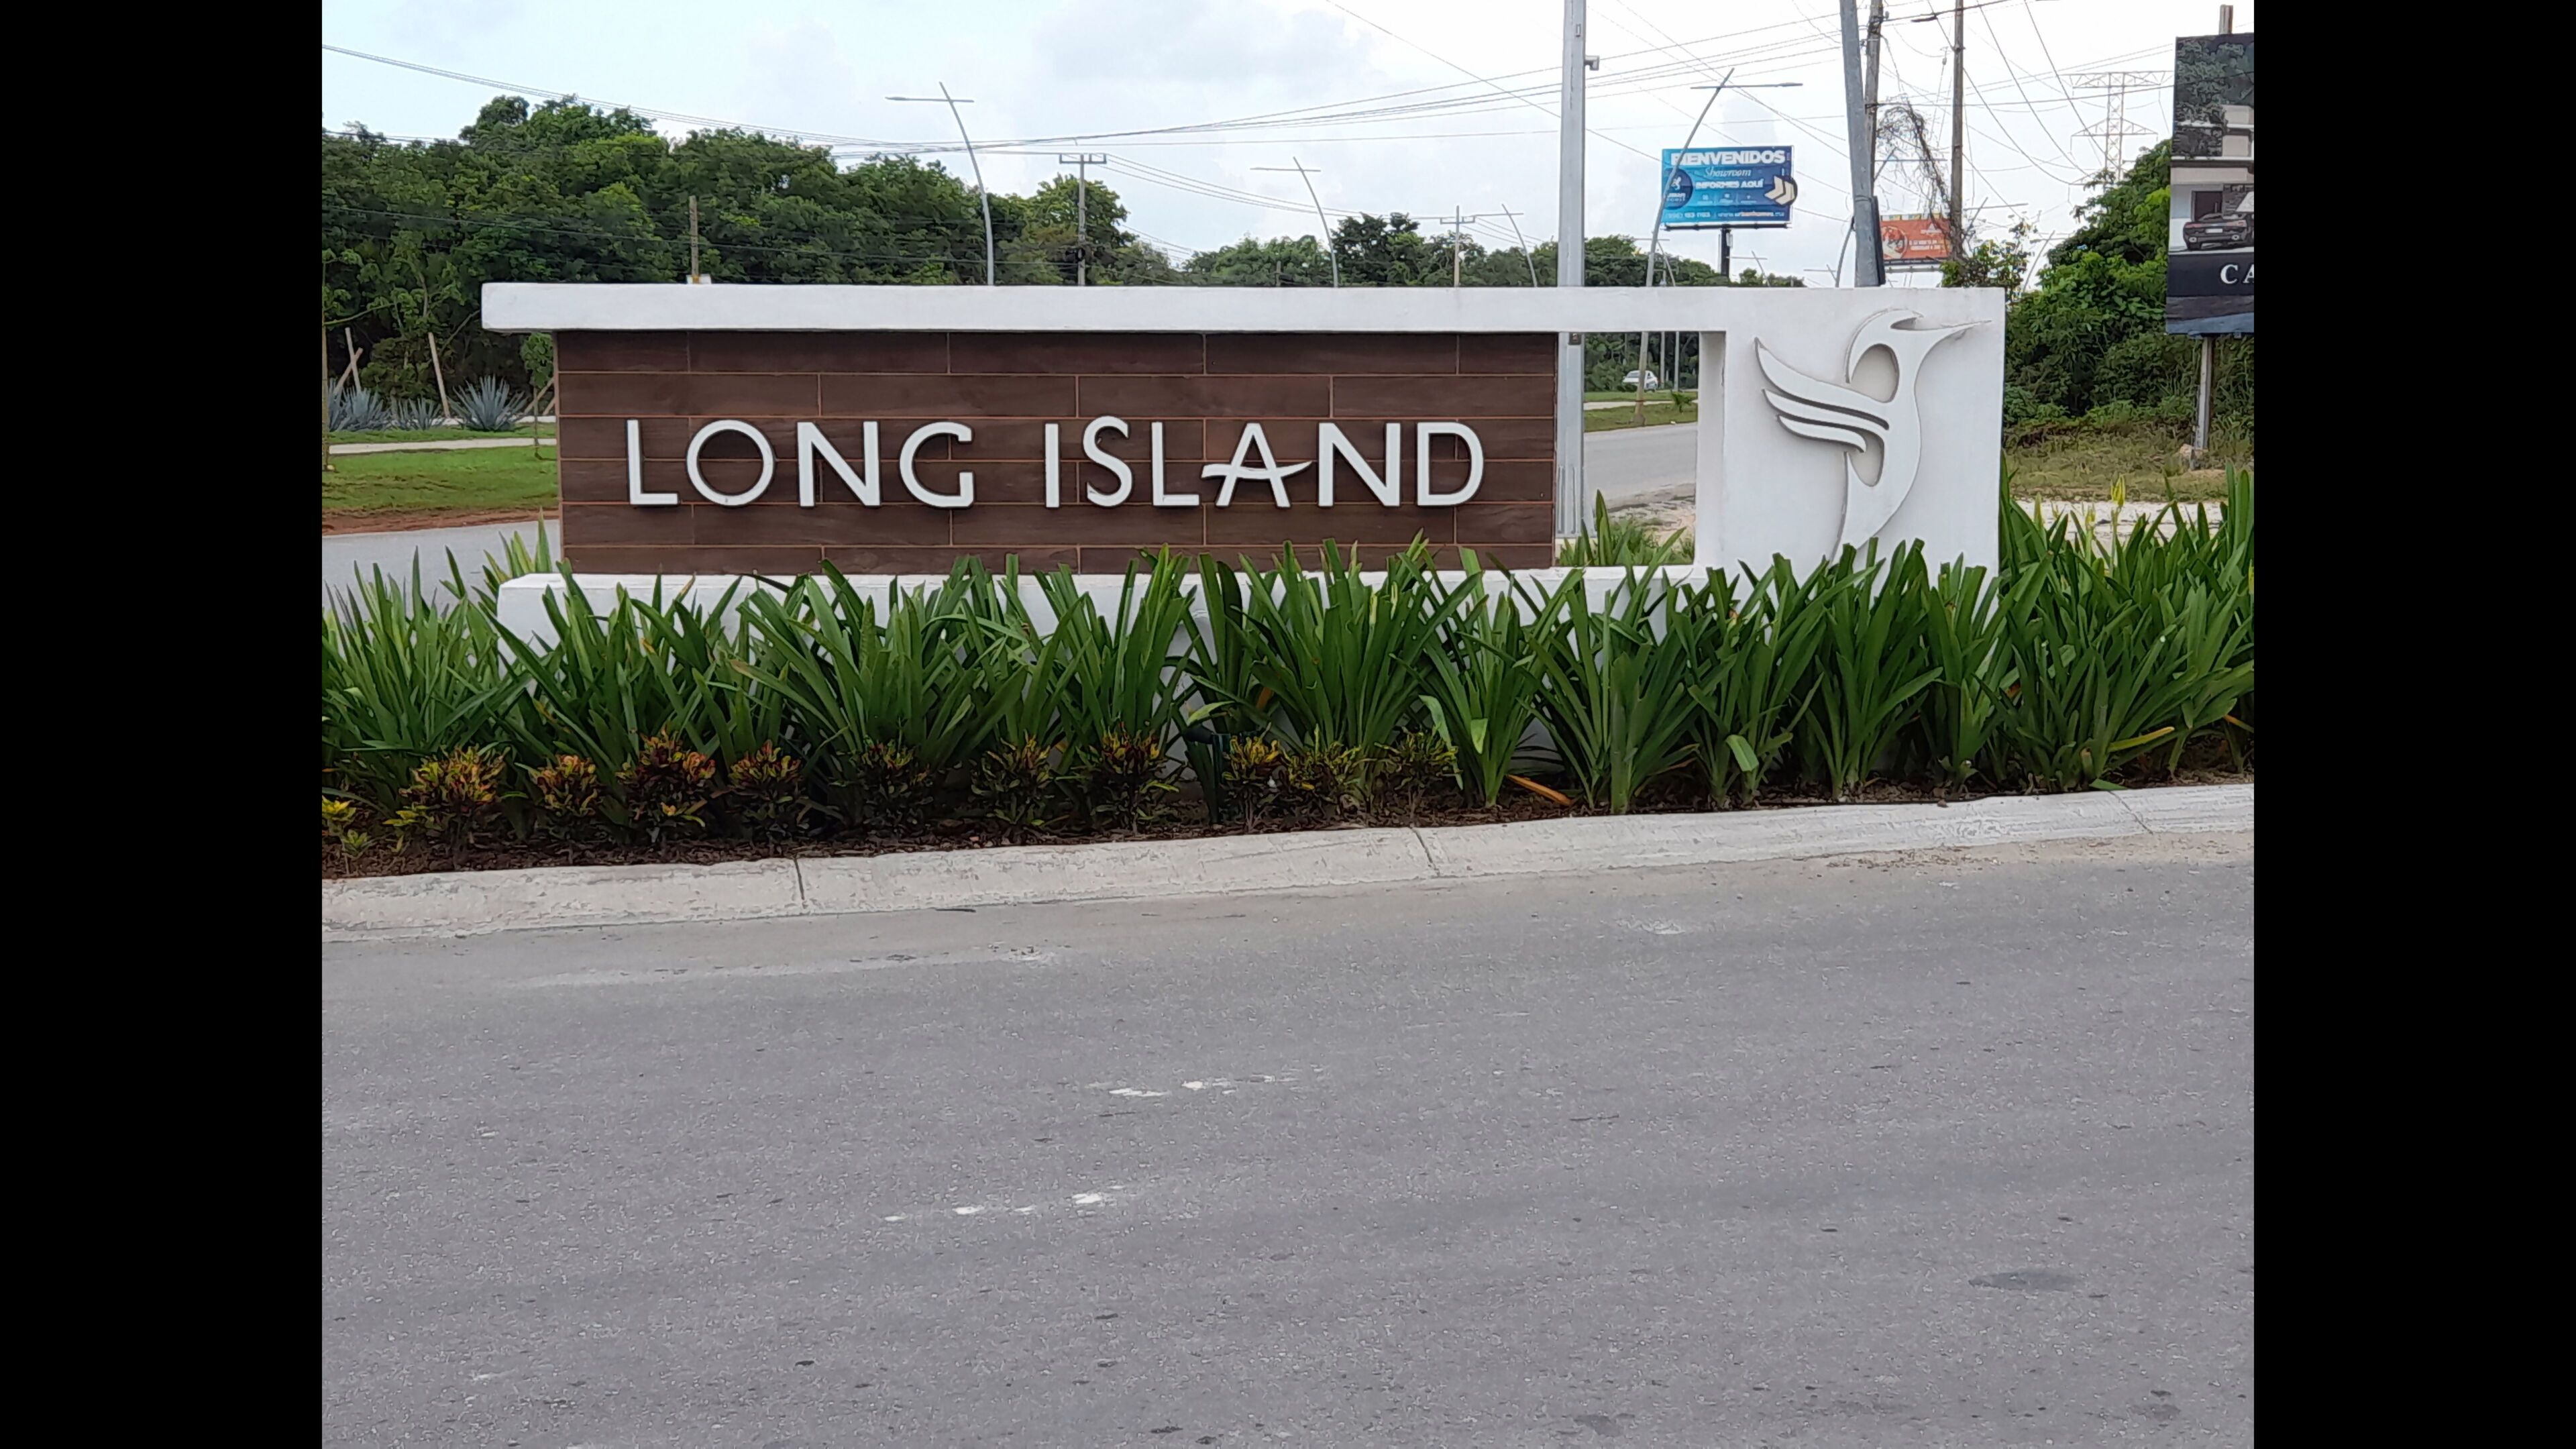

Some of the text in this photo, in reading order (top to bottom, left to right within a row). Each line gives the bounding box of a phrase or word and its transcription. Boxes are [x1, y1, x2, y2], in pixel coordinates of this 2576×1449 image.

[1671, 150, 1785, 166] BIENVENIDOS
[627, 415, 1484, 508] LONG ISLAND
